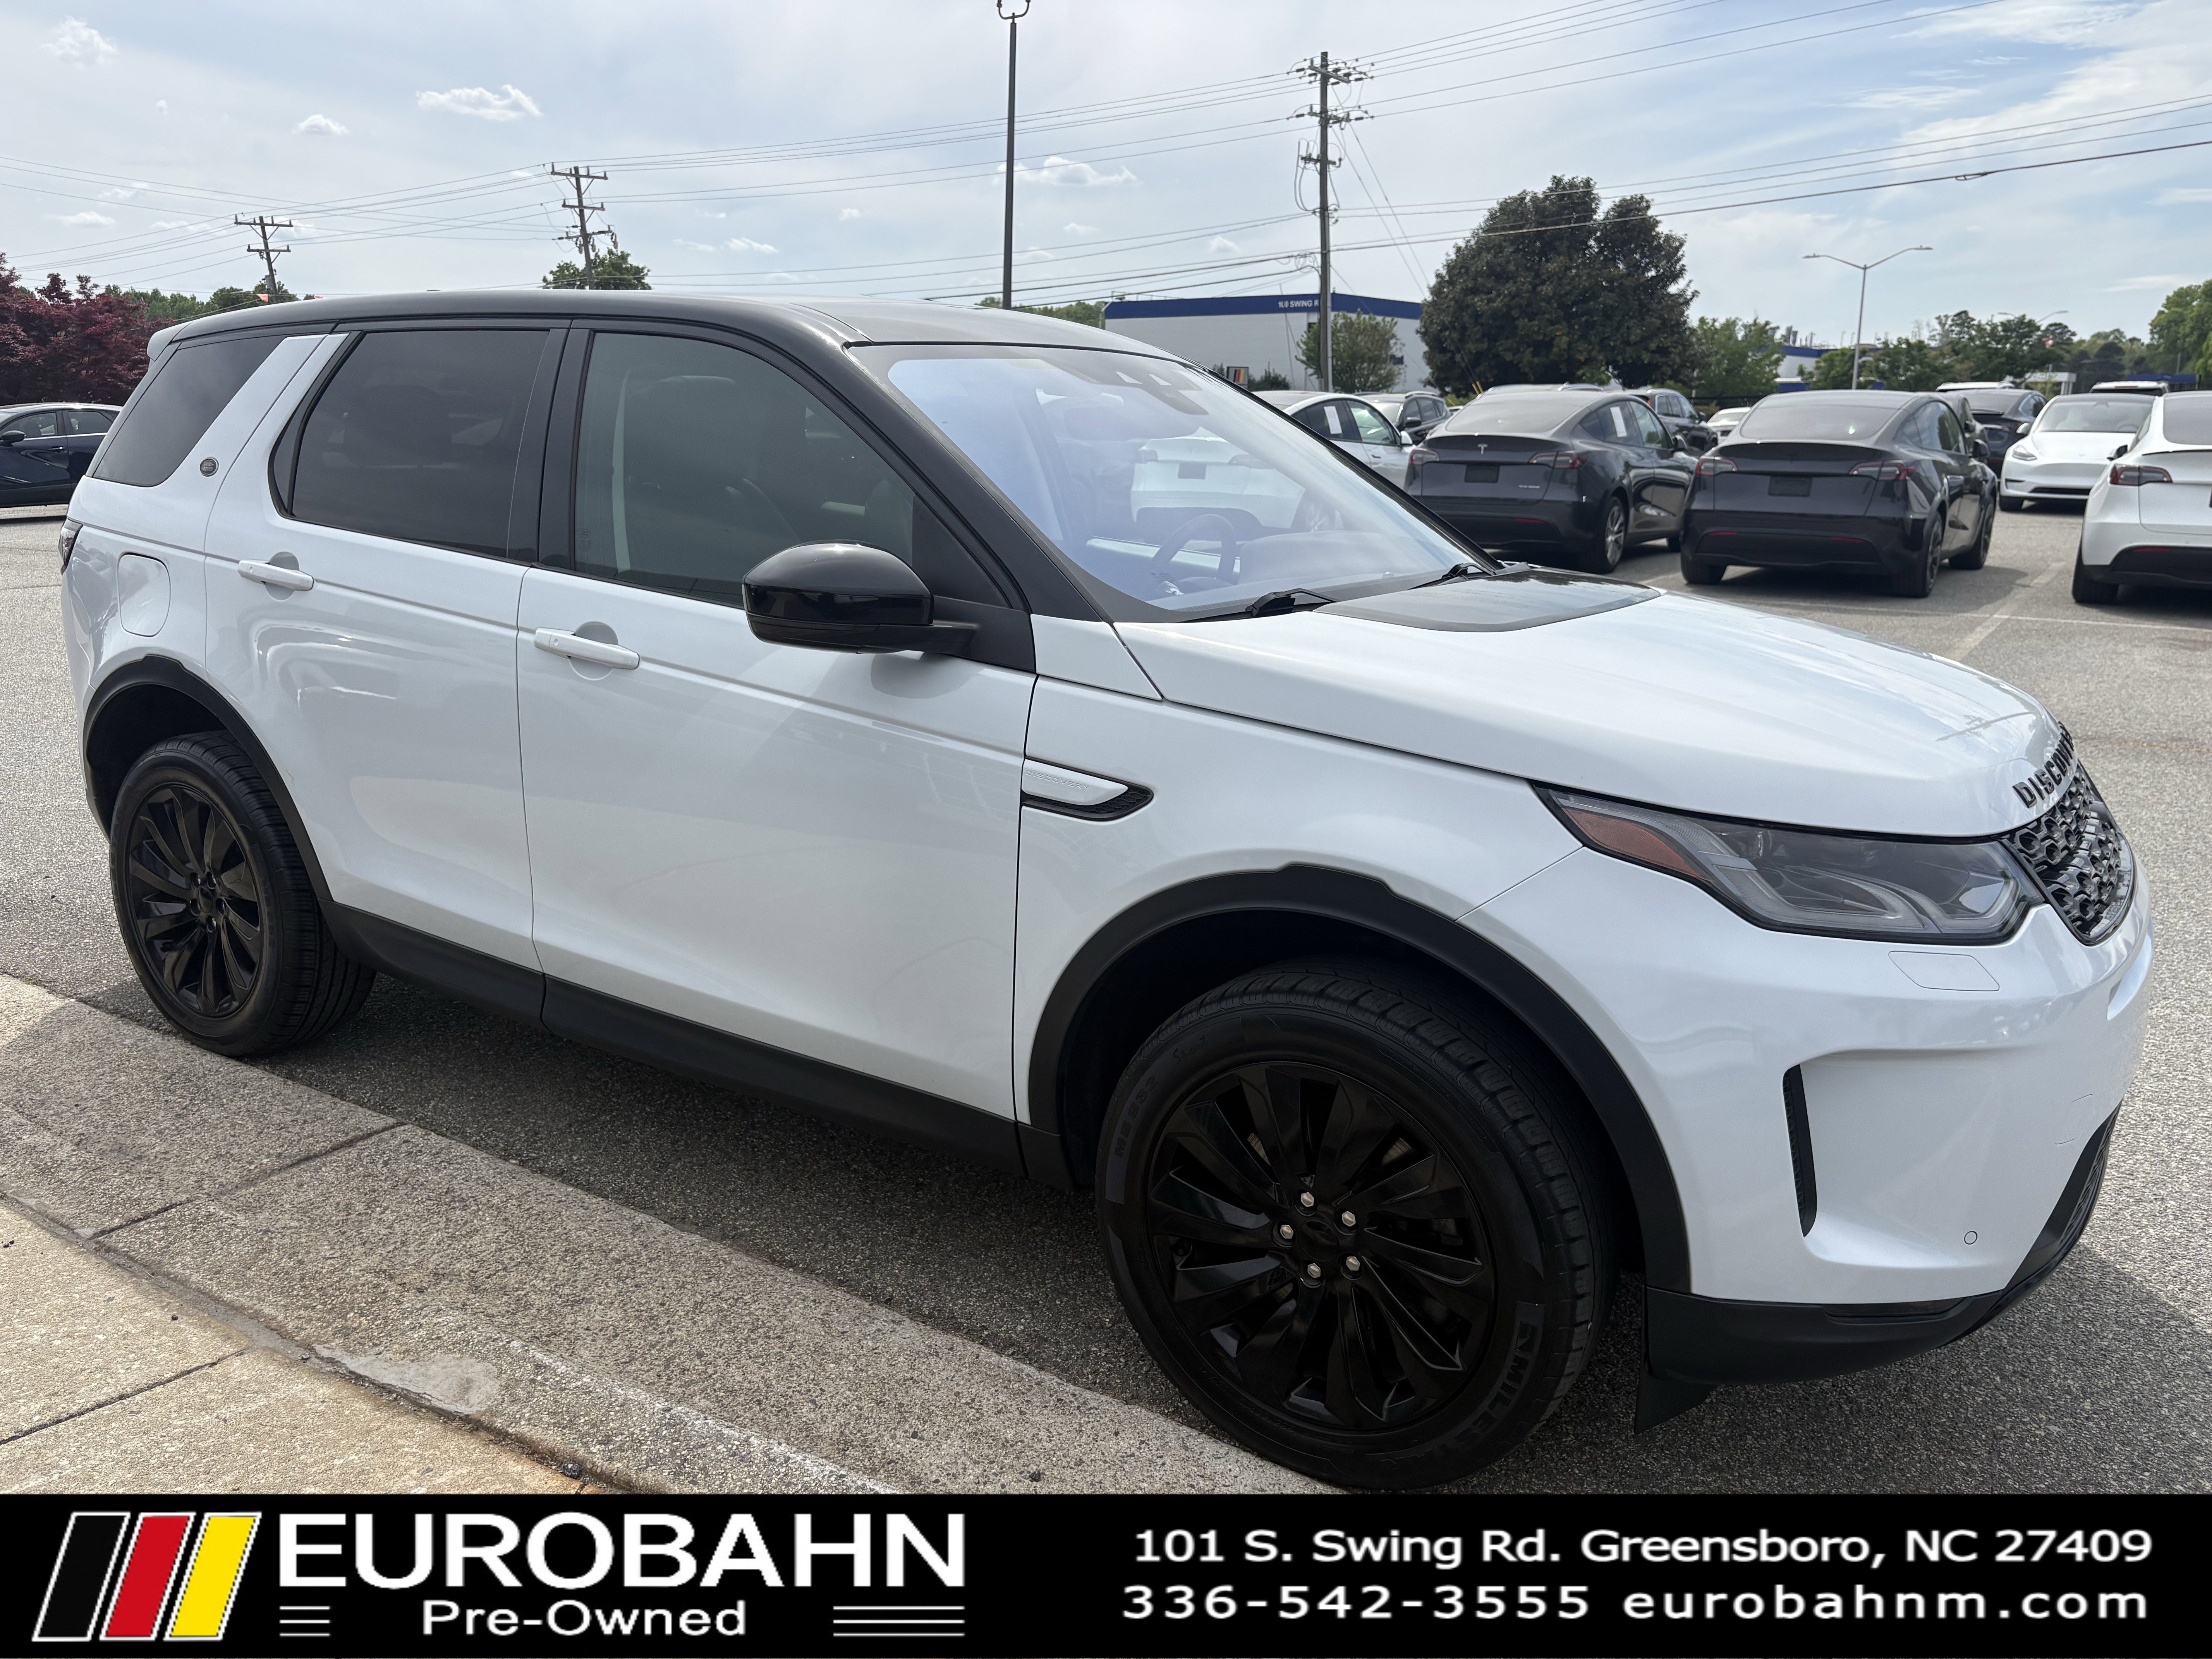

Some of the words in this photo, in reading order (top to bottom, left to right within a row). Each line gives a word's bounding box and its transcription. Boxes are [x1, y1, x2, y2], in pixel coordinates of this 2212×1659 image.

[1026, 770, 1089, 790] DISCOVERY
[2012, 721, 2074, 808] DISCOV
[1115, 1075, 1159, 1158] MS932
